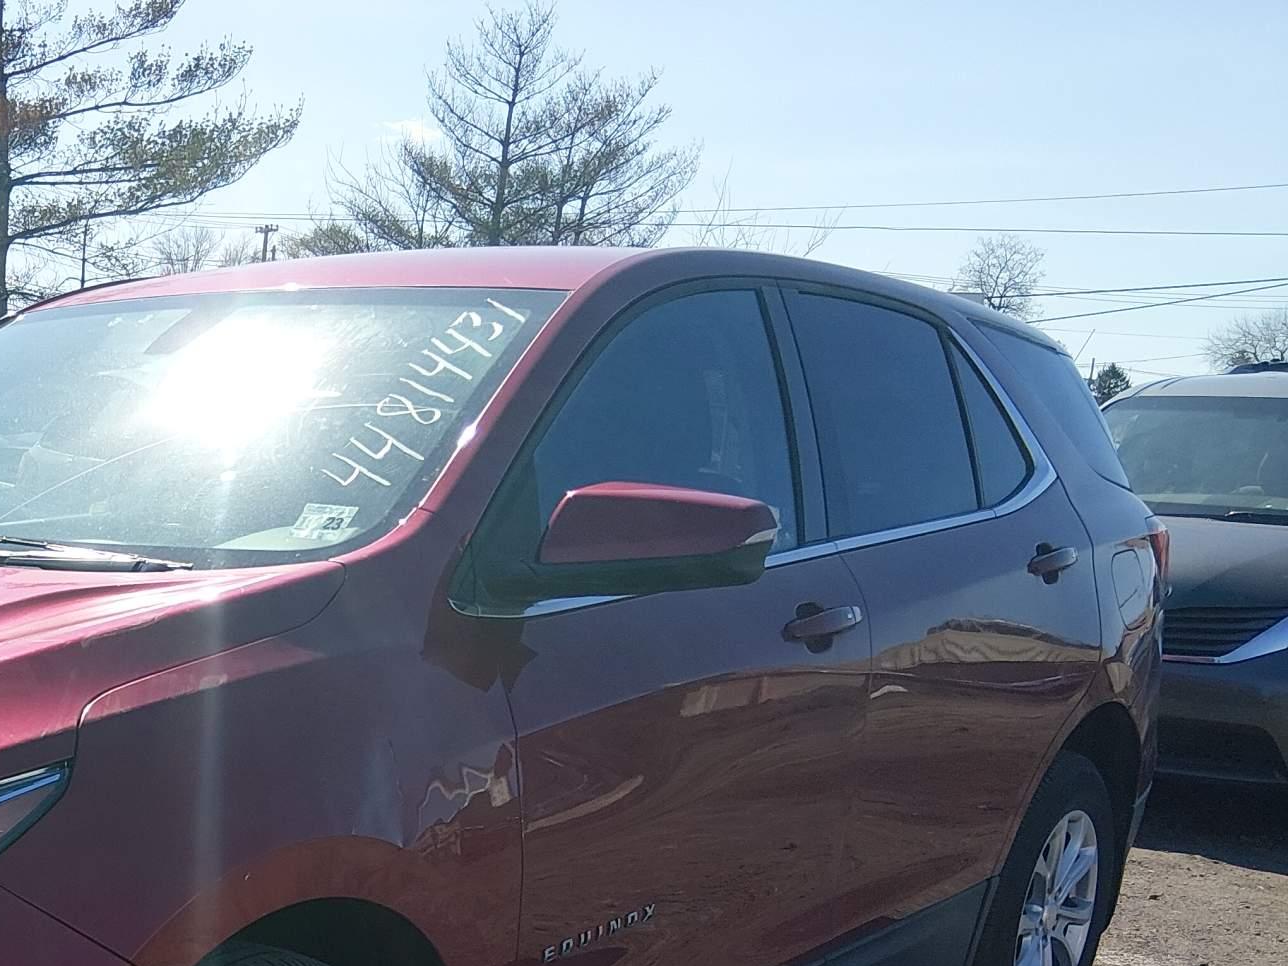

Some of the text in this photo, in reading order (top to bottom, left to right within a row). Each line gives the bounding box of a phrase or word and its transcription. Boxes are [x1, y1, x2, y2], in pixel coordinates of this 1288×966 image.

[322, 298, 525, 487] 44814431
[323, 516, 344, 530] 23
[542, 903, 656, 962] EQUINOX
